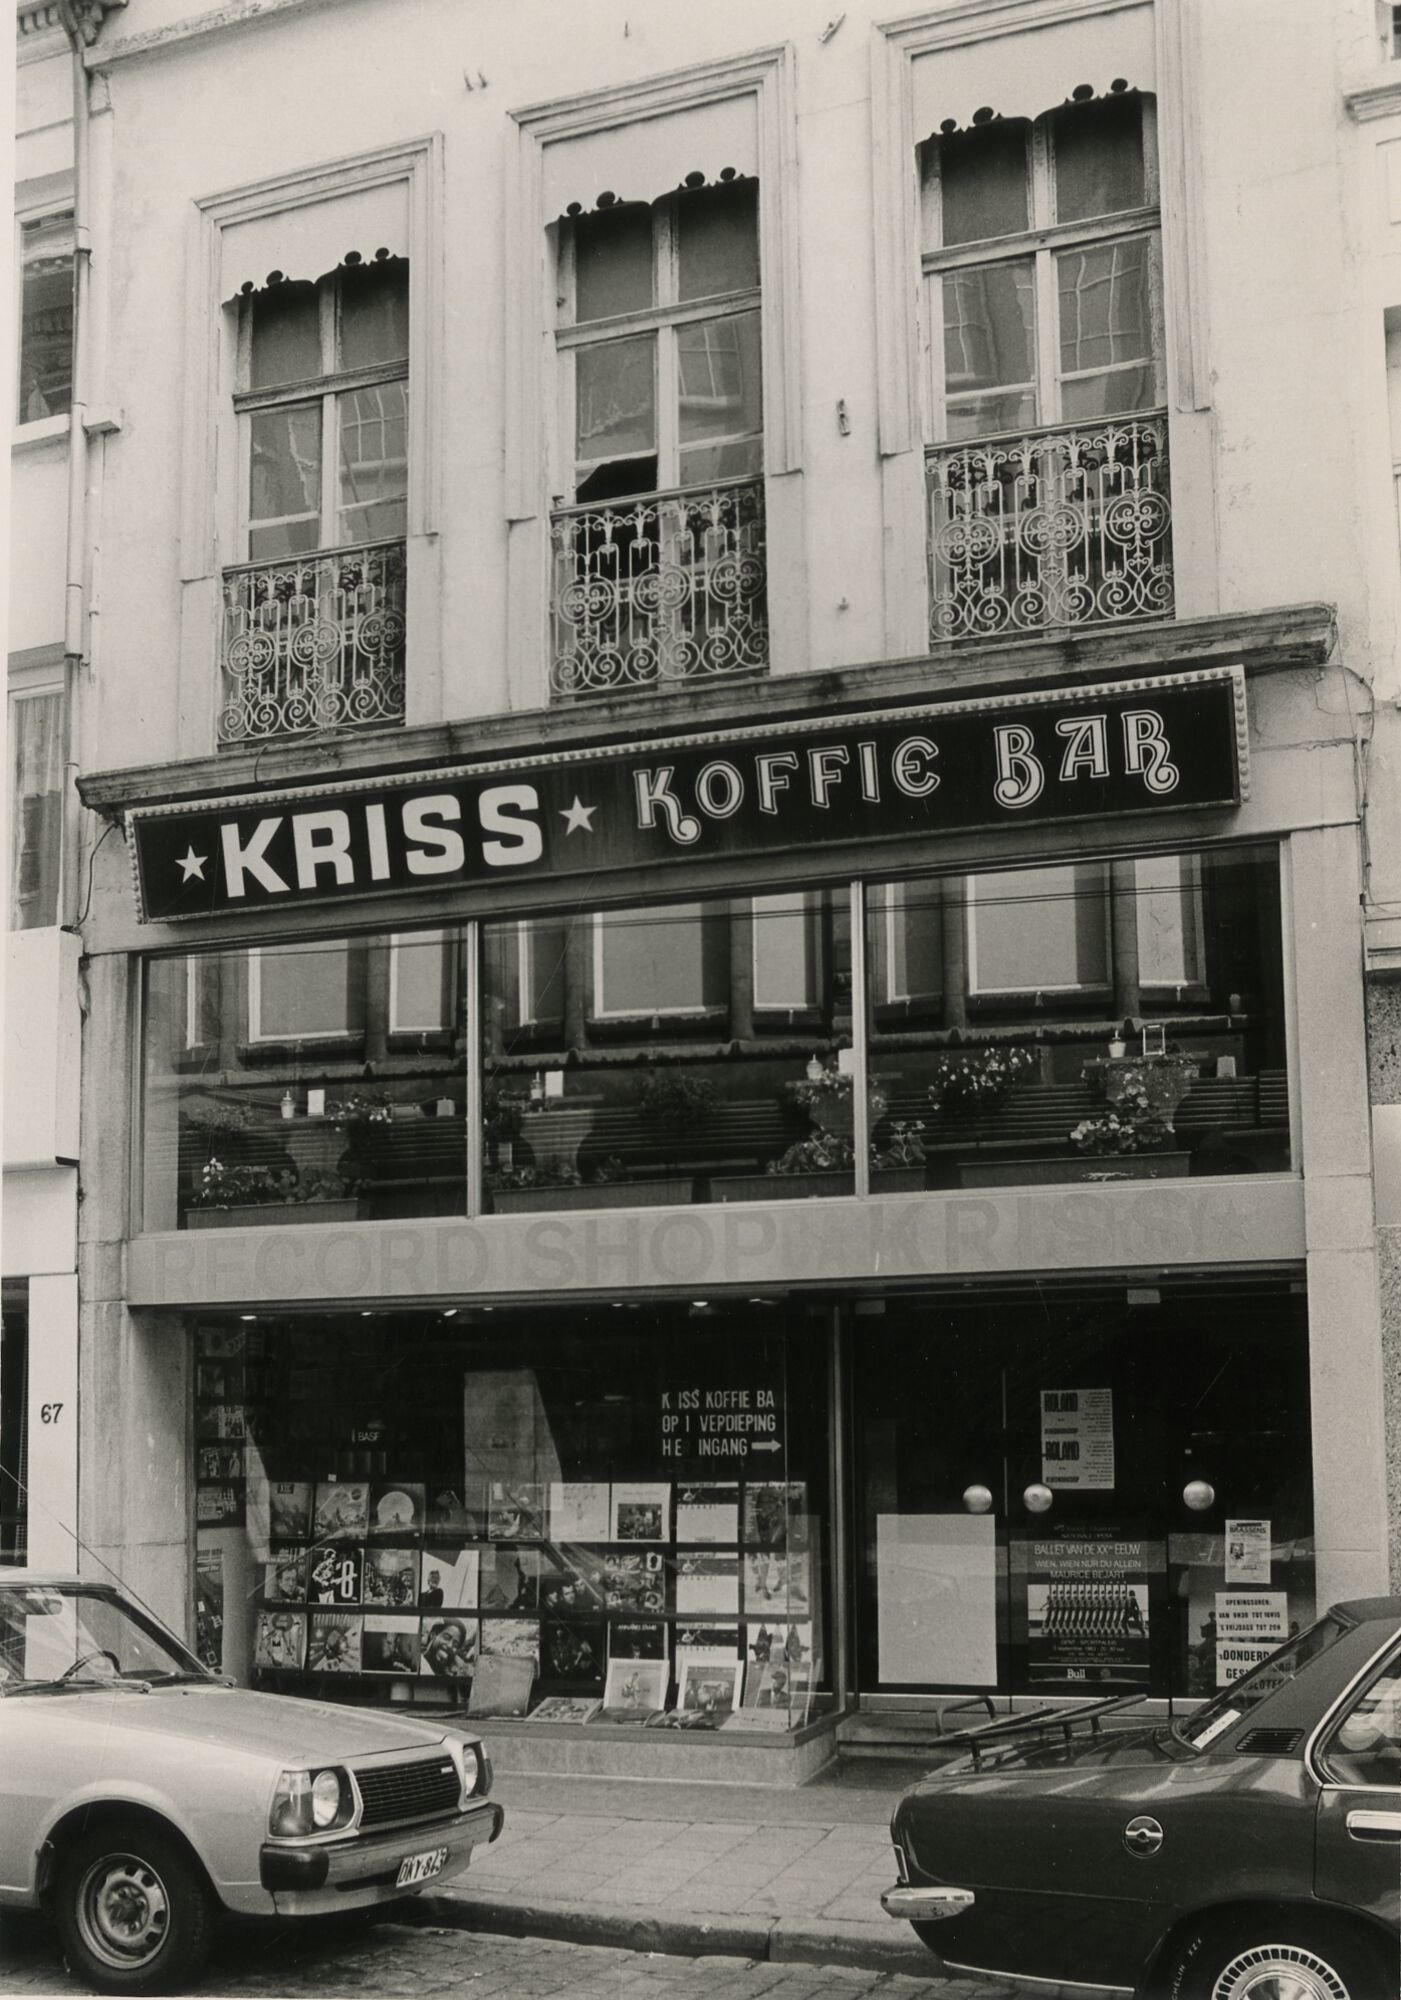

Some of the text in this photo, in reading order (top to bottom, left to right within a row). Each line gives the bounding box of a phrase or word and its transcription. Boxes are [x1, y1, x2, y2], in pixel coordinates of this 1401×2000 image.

[222, 708, 1180, 898] KRISS KOFFIE BAR
[154, 1225, 490, 1302] RECORD
[521, 1209, 775, 1290] SHOP
[705, 1390, 750, 1408] KOFFIE
[41, 1403, 64, 1424] 67
[662, 1415, 679, 1432] OP
[698, 1438, 748, 1456] INGANG
[1034, 1544, 1064, 1555] BALLET
[1065, 1544, 1083, 1555] VAN
[1084, 1544, 1096, 1555] DE
[1115, 1543, 1141, 1555] EEUW
[1100, 1560, 1112, 1568] DU
[1050, 1569, 1090, 1579] MAURICE
[1067, 1668, 1086, 1679] Bull
